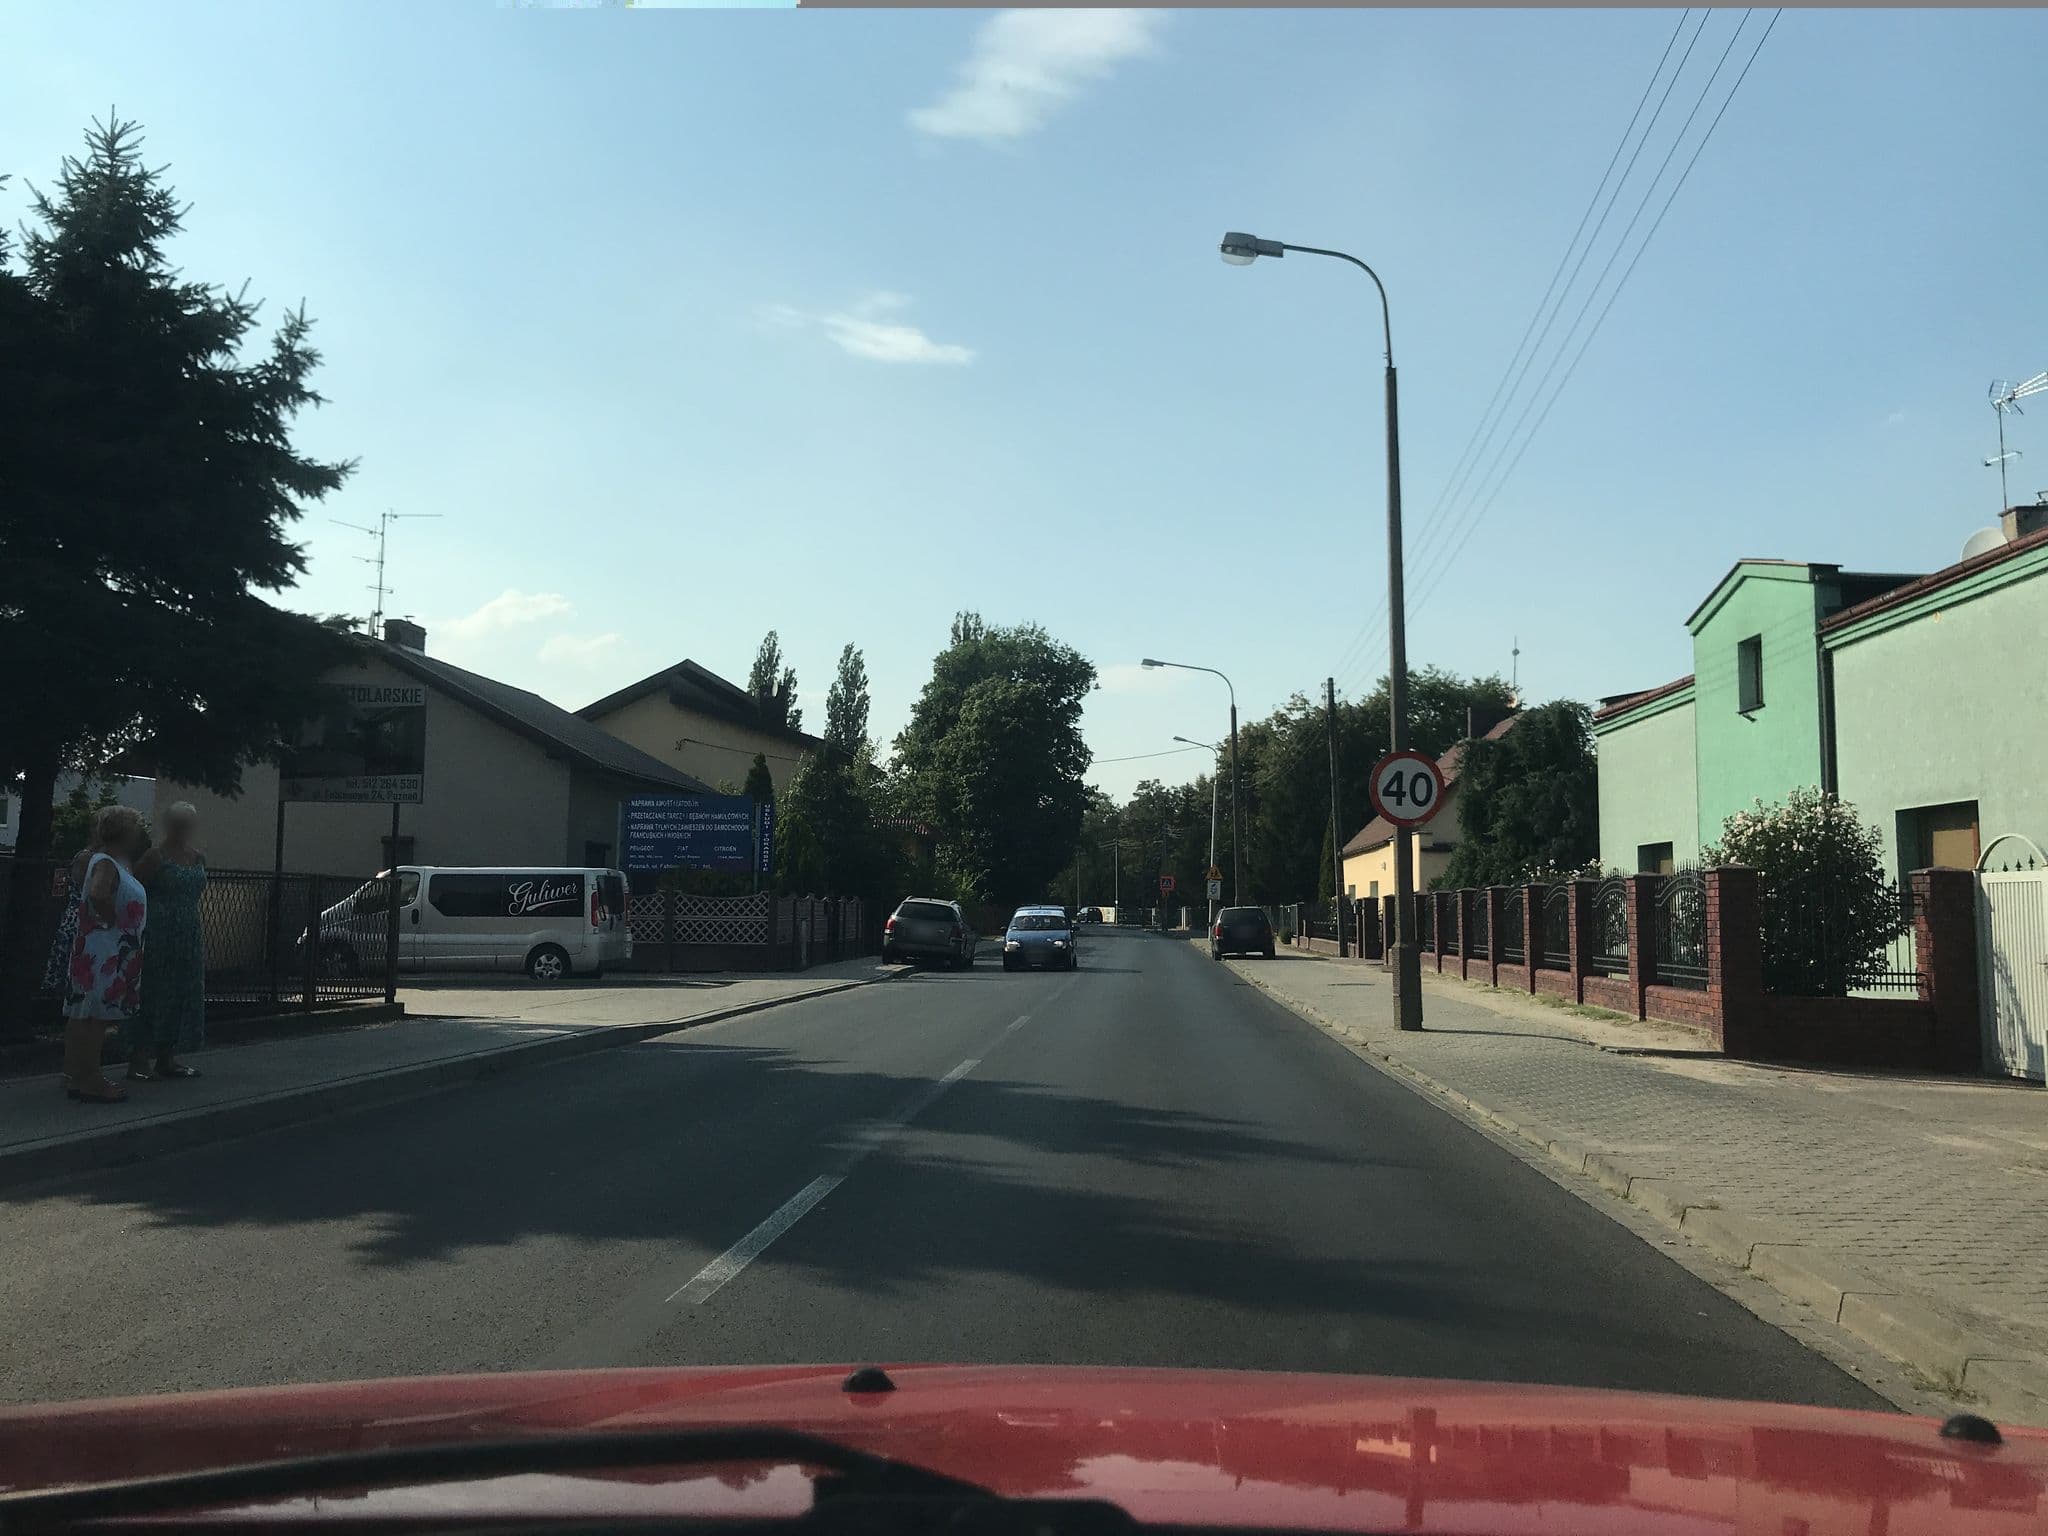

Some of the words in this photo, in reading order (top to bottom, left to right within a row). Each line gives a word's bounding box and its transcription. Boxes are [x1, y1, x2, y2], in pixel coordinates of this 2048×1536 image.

[400, 778, 418, 790] 530
[1382, 769, 1433, 808] 40
[630, 823, 654, 831] NAPRAWA
[508, 879, 578, 916] Guliwer
